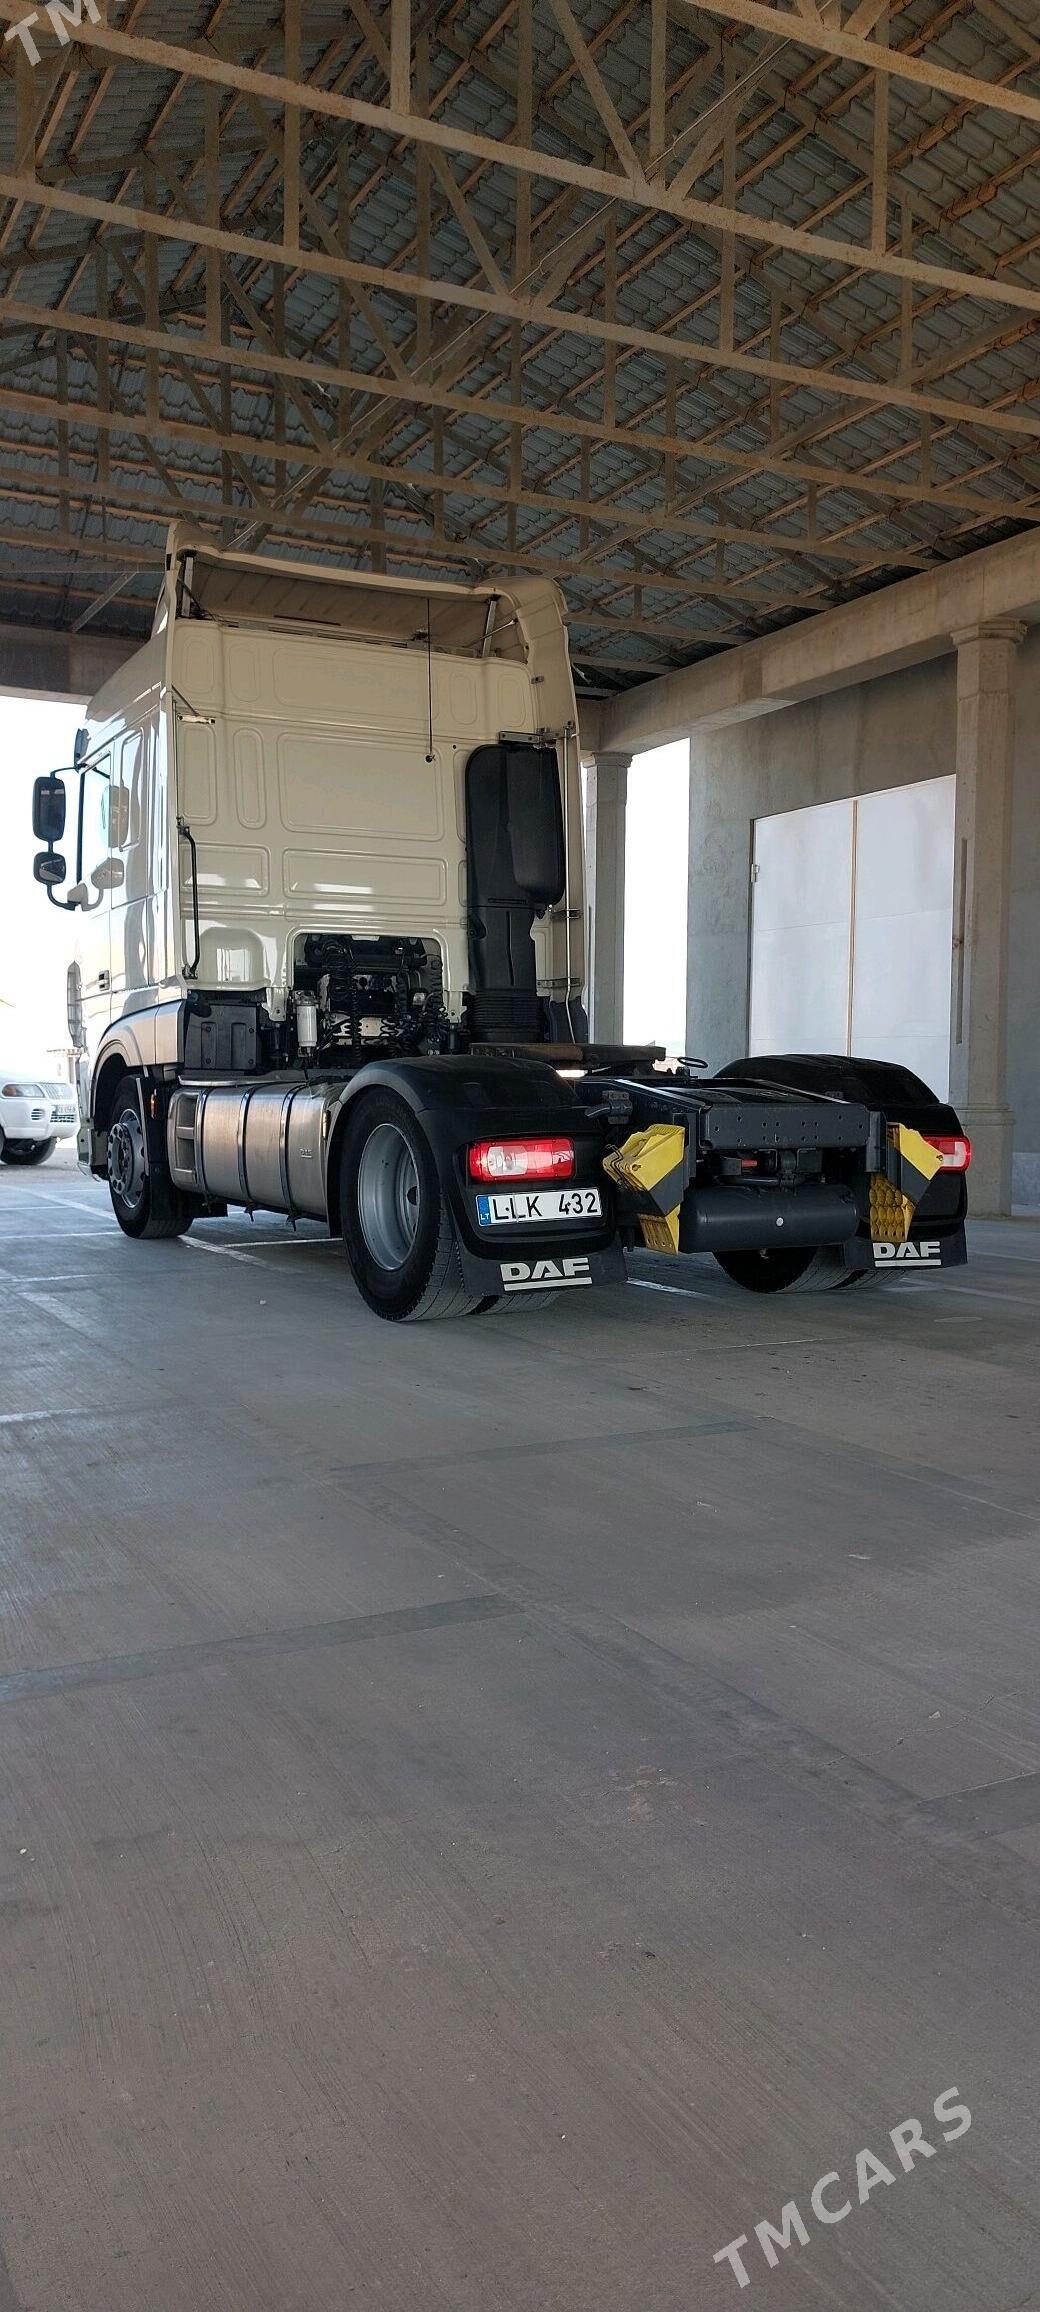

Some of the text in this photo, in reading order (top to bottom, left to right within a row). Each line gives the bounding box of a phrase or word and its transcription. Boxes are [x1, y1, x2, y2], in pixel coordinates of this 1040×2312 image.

[480, 1212, 490, 1220] LT
[492, 1192, 598, 1220] LLK 432
[872, 1241, 941, 1259] DAF
[500, 1257, 590, 1281] DAF
